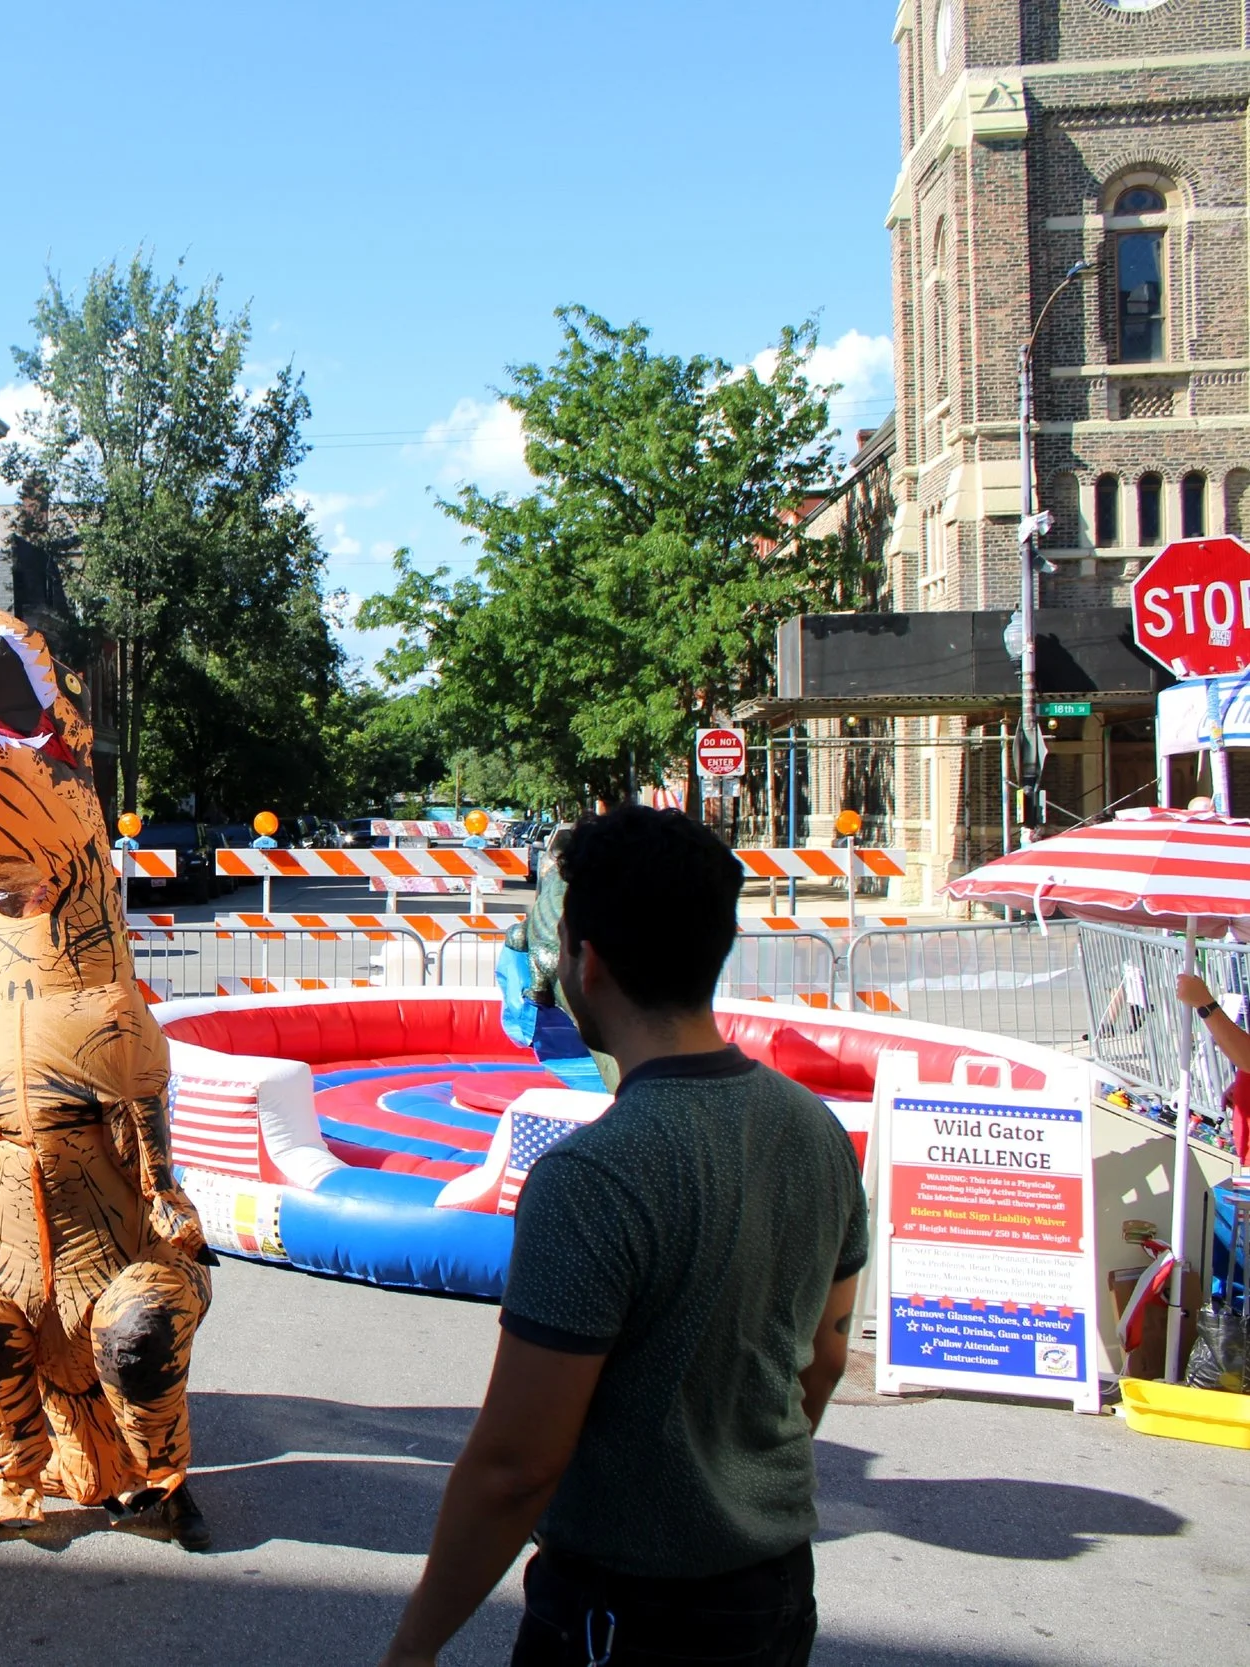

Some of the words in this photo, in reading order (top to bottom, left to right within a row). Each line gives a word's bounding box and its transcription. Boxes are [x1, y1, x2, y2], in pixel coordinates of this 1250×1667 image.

[1054, 704, 1074, 714] 18th
[703, 738, 716, 747] DO
[719, 738, 736, 747] NOT
[707, 758, 734, 767] ENTER
[934, 1118, 982, 1137] Wild
[988, 1122, 1045, 1142] Gator
[927, 1145, 1051, 1169] CHALLENGE
[926, 1172, 968, 1183] WARNING:
[969, 1176, 985, 1184] This
[986, 1178, 1002, 1186] ride
[1017, 1180, 1056, 1191] Physically
[916, 1192, 934, 1200] This
[934, 1194, 977, 1203] Mechanical
[978, 1197, 996, 1206] Ride
[1012, 1199, 1035, 1208] throw
[920, 1182, 964, 1194] Demanding
[965, 1186, 991, 1196] Highly
[992, 1188, 1016, 1197] Active
[1017, 1190, 1062, 1200] Experience!
[910, 1207, 941, 1217] Riders
[943, 1209, 967, 1219] Must
[969, 1211, 990, 1222] Sign
[993, 1213, 1032, 1226] Liability
[1033, 1215, 1067, 1227] Waiver
[919, 1223, 947, 1234] Height
[949, 1226, 995, 1237] Minimum/
[995, 1229, 1010, 1238] 250
[1011, 1230, 1020, 1239] lb
[1022, 1231, 1040, 1240] Max
[1041, 1233, 1072, 1244] Weight
[907, 1307, 945, 1319] Remove
[947, 1310, 986, 1324] Glasses,
[988, 1314, 1020, 1327] Shoes,
[1022, 1317, 1031, 1327] &
[1032, 1318, 1071, 1332] Jewelry
[921, 1322, 934, 1332] No
[936, 1323, 961, 1336] Food,
[963, 1326, 996, 1339] Drinks,
[997, 1329, 1020, 1339] Gum
[1021, 1333, 1034, 1341] on
[1035, 1332, 1057, 1343] Ride
[932, 1338, 962, 1349] Follow
[964, 1341, 1010, 1353] Attendant
[943, 1352, 999, 1366] Instructions
